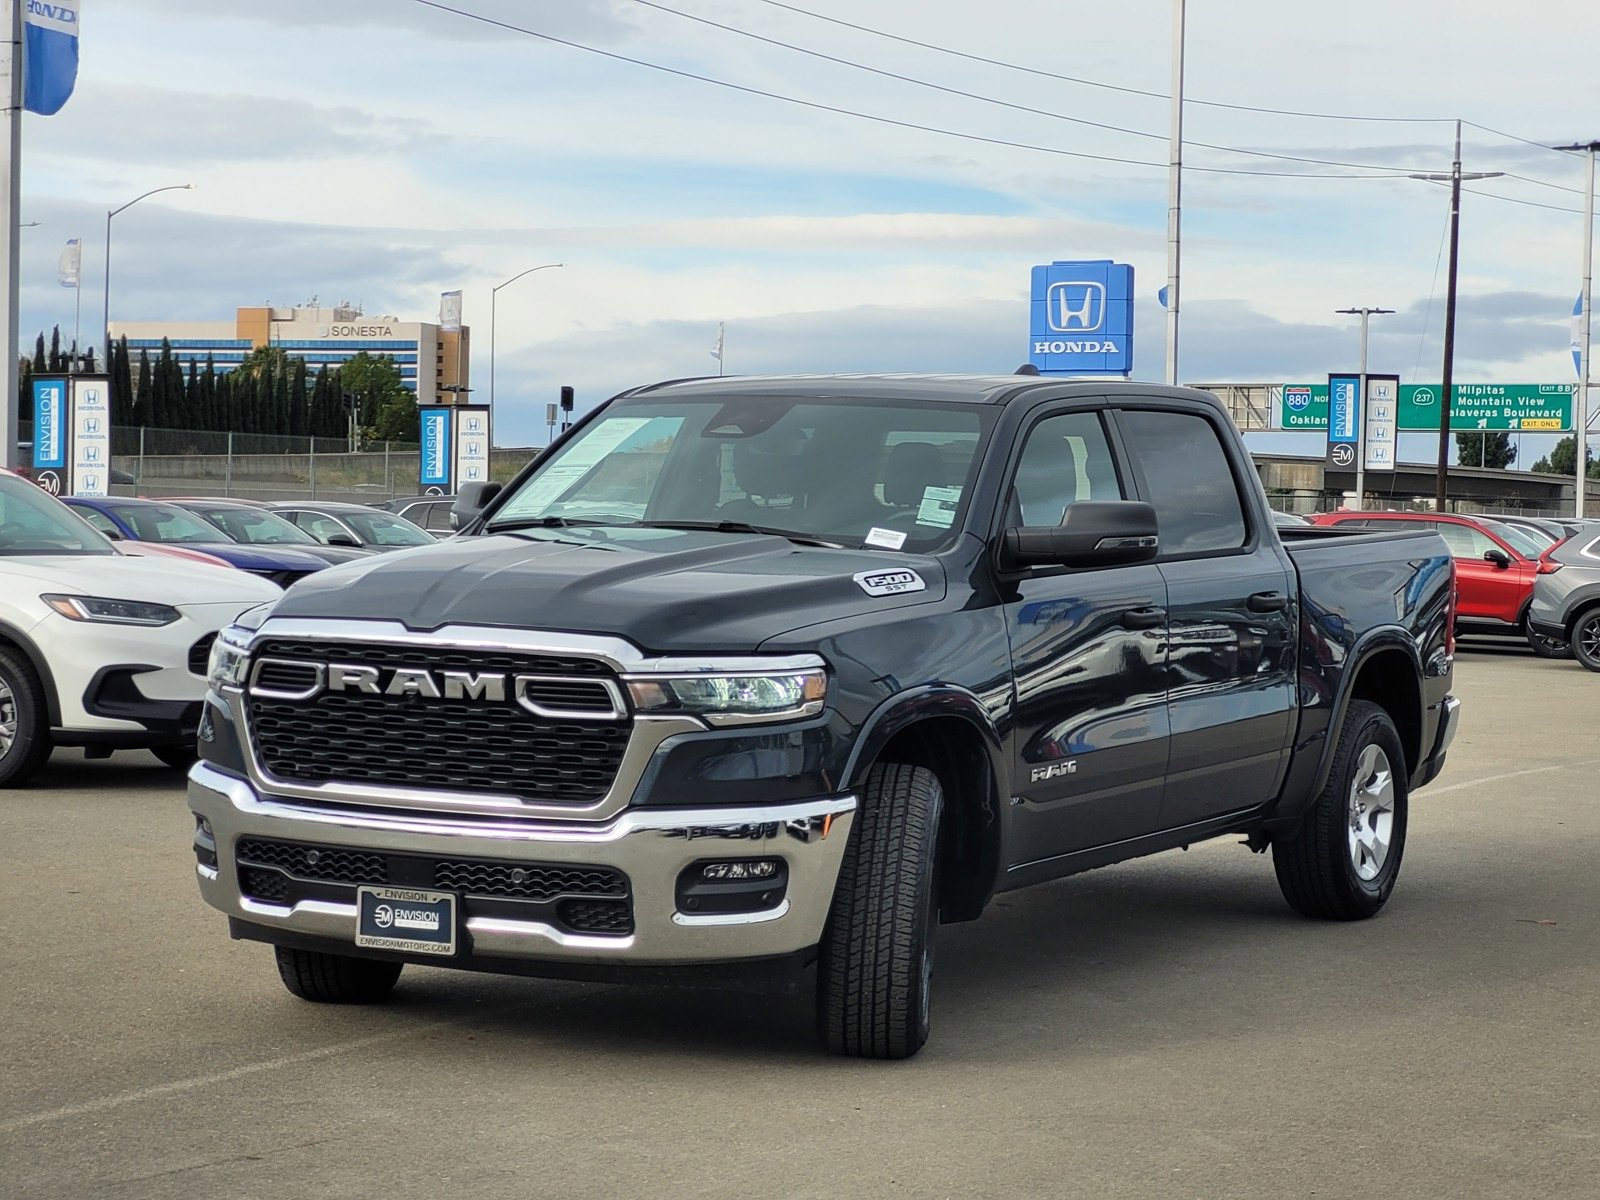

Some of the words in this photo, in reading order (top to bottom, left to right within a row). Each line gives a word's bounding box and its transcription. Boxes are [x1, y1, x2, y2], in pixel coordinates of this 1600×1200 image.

[331, 326, 392, 337] SONESTA
[1034, 341, 1119, 353] HONDA
[1458, 385, 1505, 396] Milpitas
[1288, 394, 1308, 405] 880
[1416, 393, 1431, 402] 237
[1458, 397, 1512, 406] Mountain
[1518, 397, 1545, 406] View
[1335, 383, 1346, 437] ENVISION
[1449, 408, 1498, 417] alaveras
[1504, 408, 1562, 417] Boulevard
[40, 388, 50, 461] ENVISION
[1290, 415, 1328, 424] Oaklan
[427, 416, 437, 478] ENVISION
[865, 573, 913, 587] 1500
[328, 664, 505, 701] RAM
[384, 890, 428, 901] ENVISION
[395, 909, 439, 922] ENVISION
[360, 938, 451, 953] ENVISIONMOTORS.COM
